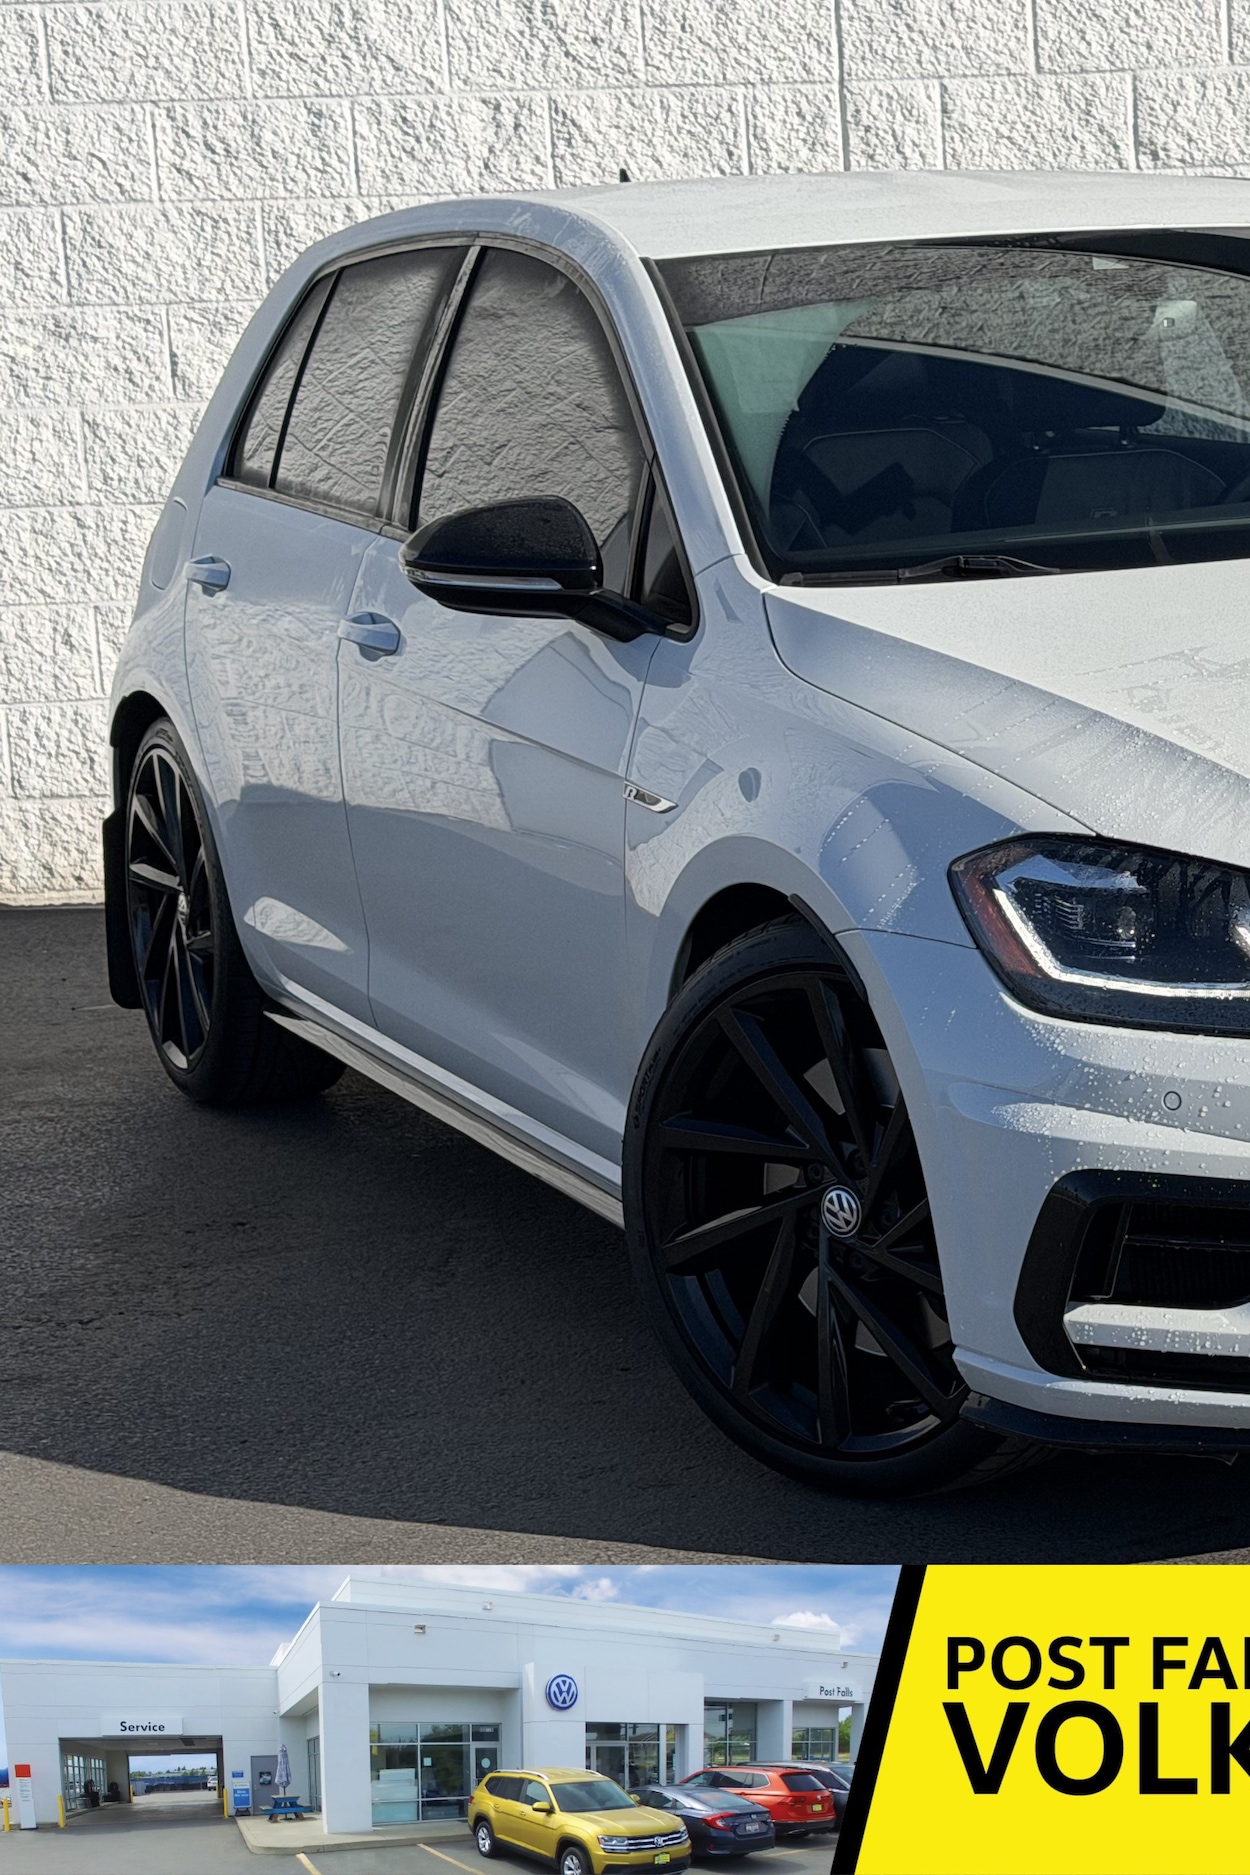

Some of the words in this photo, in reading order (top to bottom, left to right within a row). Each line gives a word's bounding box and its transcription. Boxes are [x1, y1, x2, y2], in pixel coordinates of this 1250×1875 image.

[624, 785, 638, 800] R
[819, 1686, 835, 1696] Post
[836, 1686, 853, 1697] Falls
[120, 1721, 165, 1732] Service
